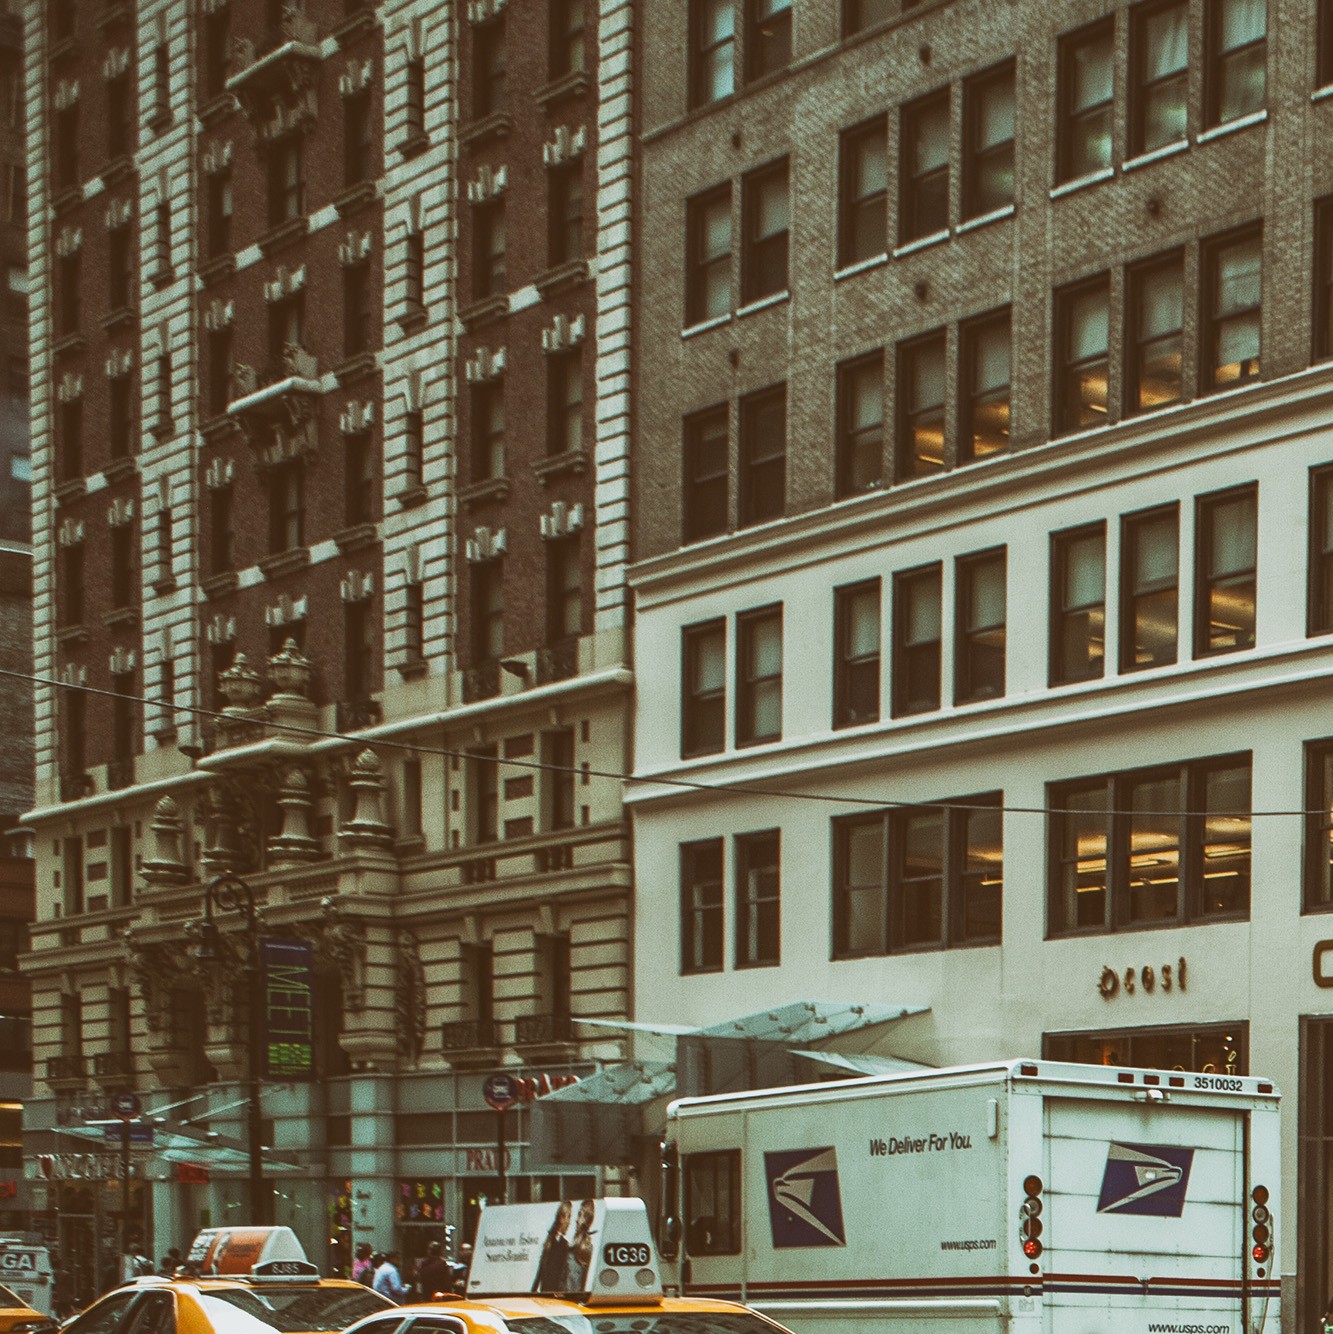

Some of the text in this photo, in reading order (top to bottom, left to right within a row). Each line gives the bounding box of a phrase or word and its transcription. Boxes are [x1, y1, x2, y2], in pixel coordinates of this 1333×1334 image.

[1194, 1077, 1243, 1092] 3510032
[870, 1132, 972, 1156] We Deliver For You.
[941, 1239, 996, 1253] www.usps.com
[607, 1246, 648, 1263] 1G36
